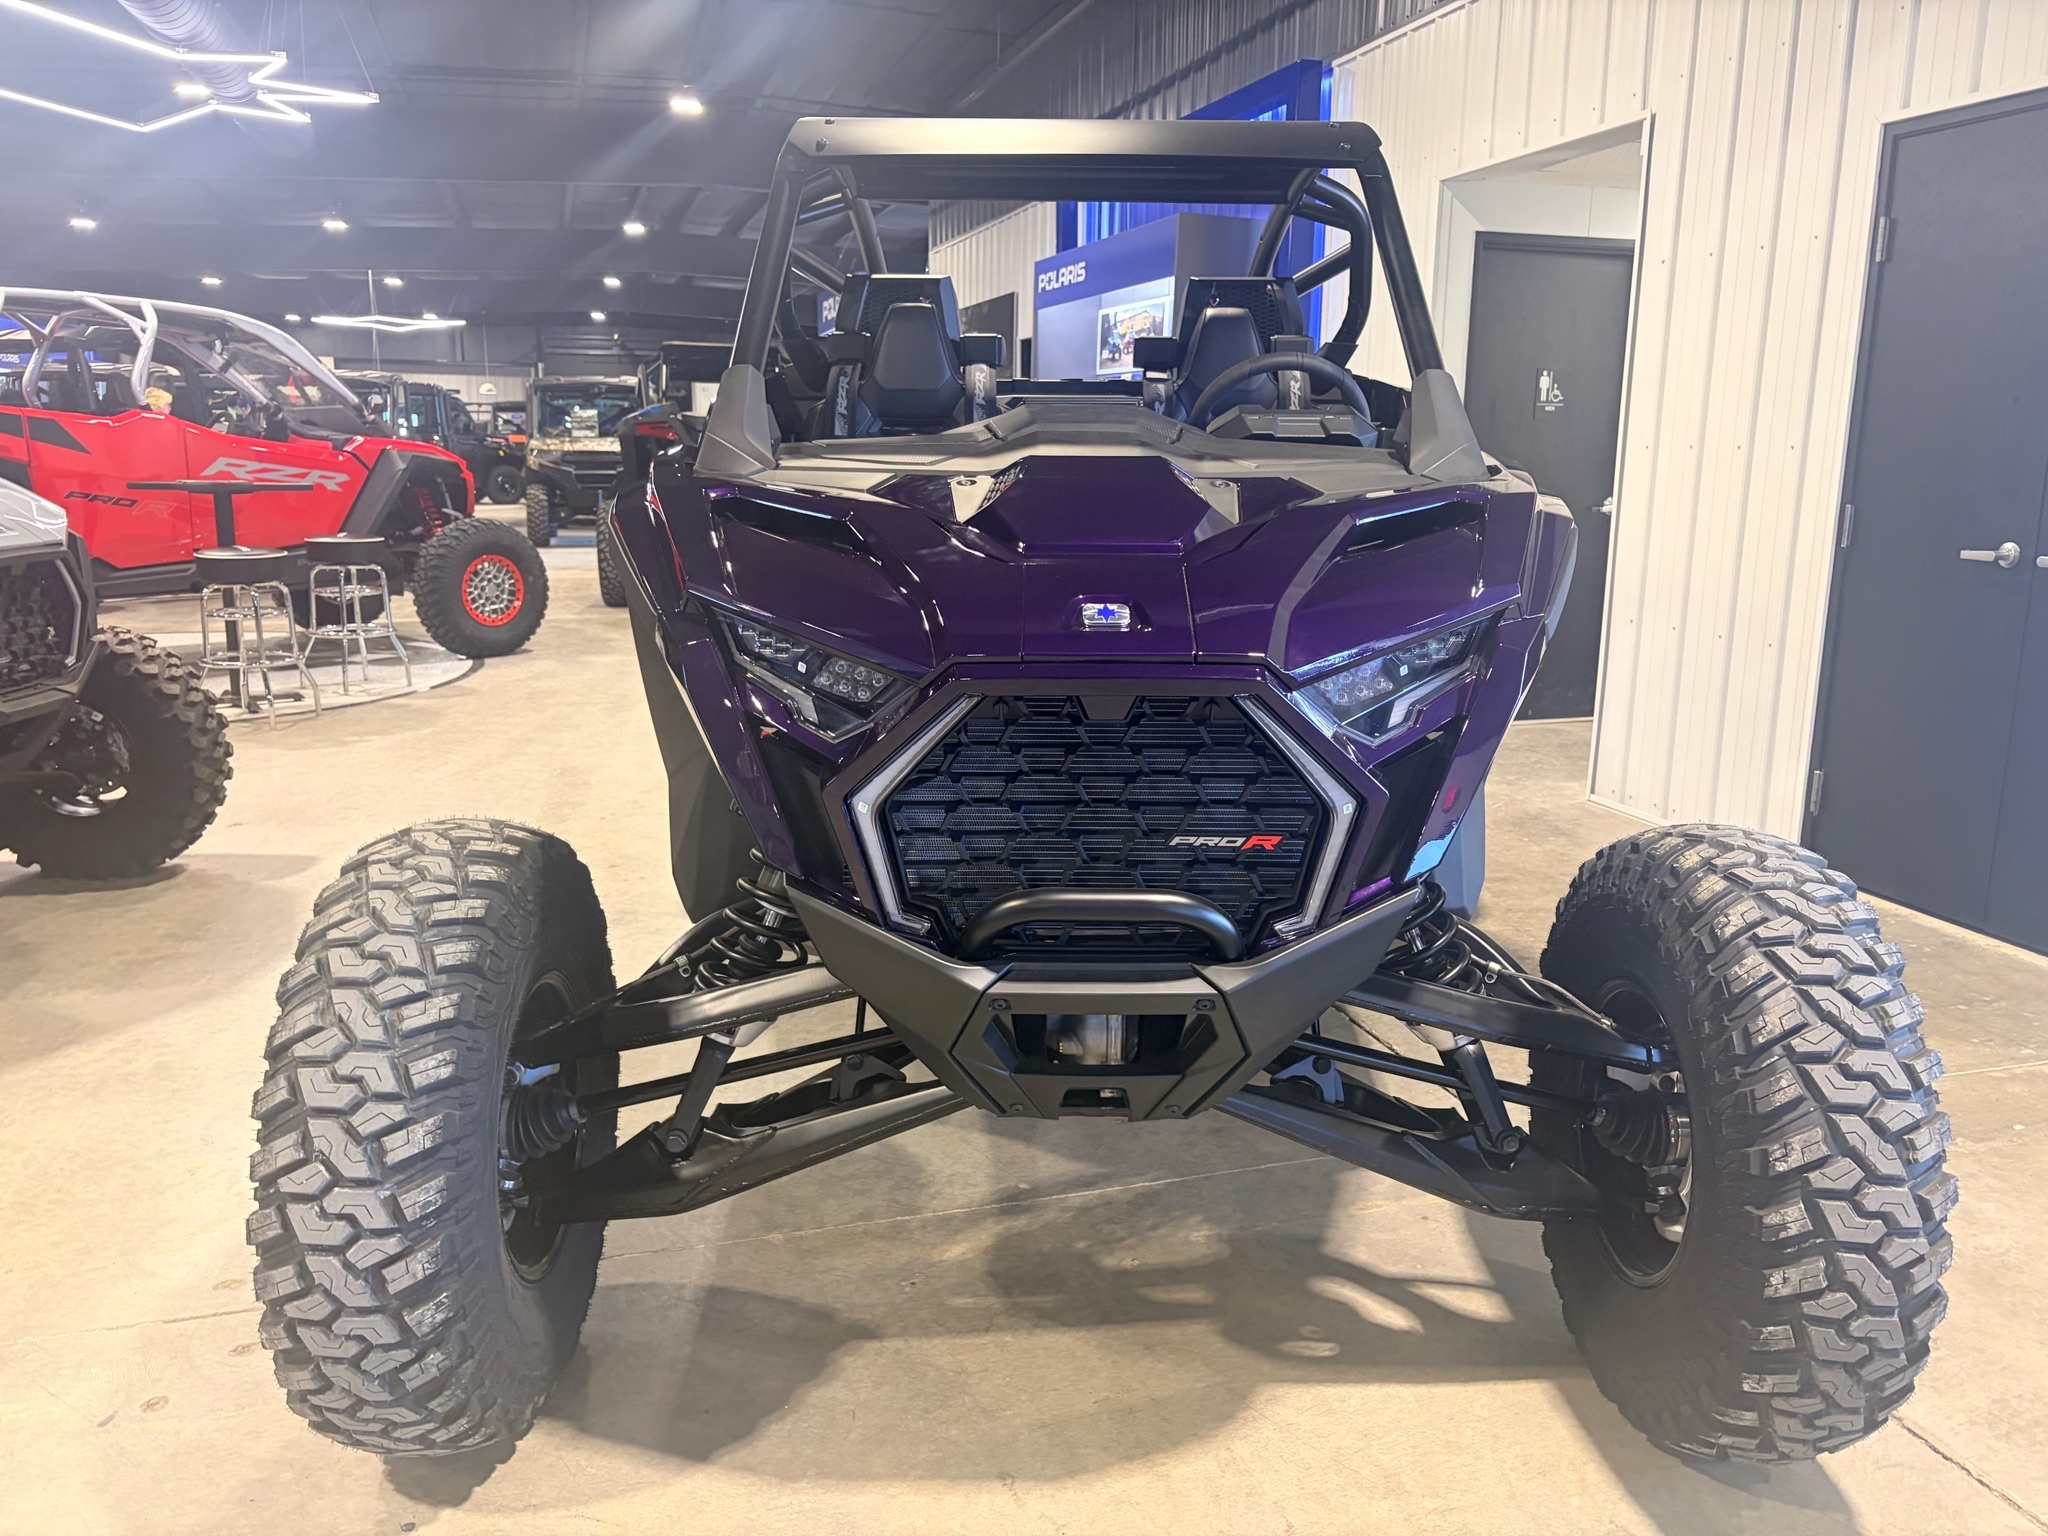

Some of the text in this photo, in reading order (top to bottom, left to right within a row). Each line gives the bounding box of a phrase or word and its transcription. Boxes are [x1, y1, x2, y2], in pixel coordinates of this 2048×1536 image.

[1038, 261, 1086, 293] POLARIS
[199, 456, 350, 492] RZR
[63, 490, 139, 509] PRO
